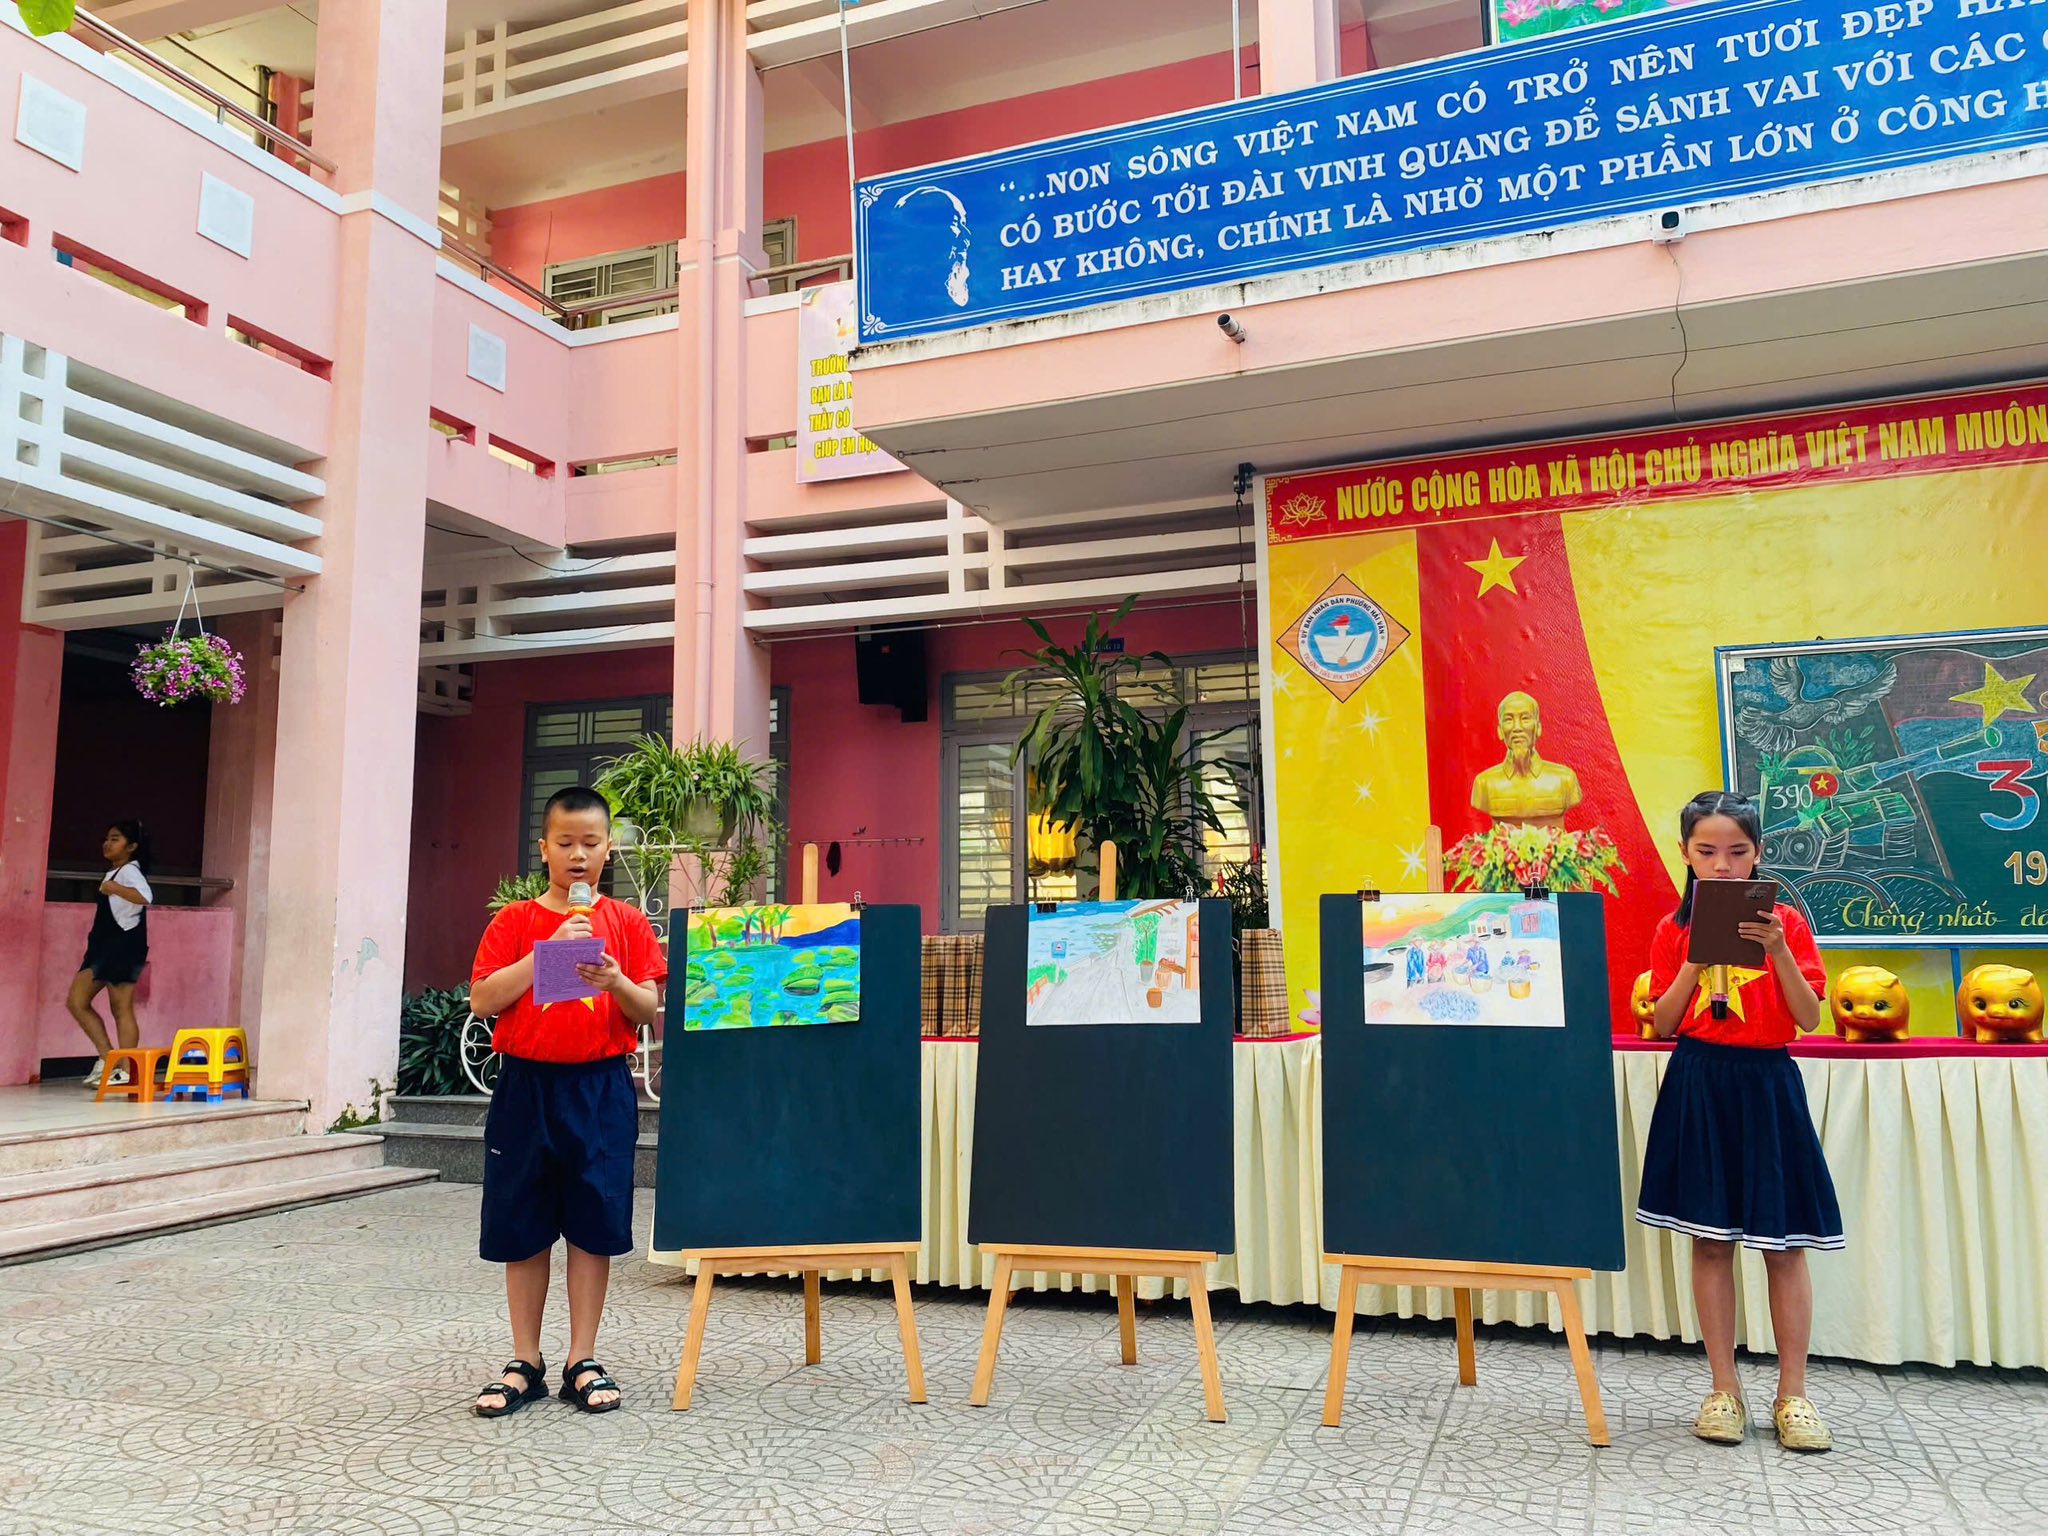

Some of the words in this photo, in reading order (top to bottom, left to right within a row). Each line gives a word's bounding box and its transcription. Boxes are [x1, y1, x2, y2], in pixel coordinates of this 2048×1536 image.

[1127, 140, 1219, 180] SÔNG
[1233, 119, 1319, 157] VIỆT
[1335, 100, 1418, 139] NAM
[1436, 80, 1487, 119] CÓ
[1506, 60, 1589, 107] TRỞ
[1609, 43, 1695, 85] NÊN
[1716, 18, 1820, 63] TƯƠI
[1840, 0, 1934, 40] ĐẸP
[1000, 212, 1041, 248] CÓ
[1053, 198, 1141, 240] BƯỚC
[1151, 182, 1211, 218] TỚI
[1221, 169, 1285, 206] ĐÀI
[1294, 152, 1386, 190] VINH
[1398, 126, 1532, 179] QUANG
[1544, 97, 1601, 147] ĐỂ
[1616, 87, 1731, 135] SÁNH
[1743, 70, 1820, 108] VAI
[1832, 49, 1914, 91] VỚI
[1929, 31, 2026, 74] CÁC
[1000, 257, 1066, 291] HAY
[1075, 233, 1204, 277] KHÔNG,
[1217, 208, 1332, 251] CHÍNH
[1343, 192, 1393, 229] LÀ
[1403, 176, 1484, 219] NHỜ
[1497, 163, 1586, 203] MỘT
[1599, 133, 1713, 187] PHẦN
[1727, 121, 1814, 163] LỚN
[1831, 105, 1860, 144] Ở
[1878, 89, 2008, 136] CÔNG
[810, 384, 831, 406] BẠN
[833, 380, 844, 401] LÀ
[815, 436, 839, 459] GIÚP
[840, 436, 855, 455] EM
[1337, 476, 1404, 520] NƯỚC
[1411, 469, 1480, 517] CỘNG
[1488, 460, 1542, 503] HÒA
[1548, 454, 1583, 497] XÃ
[1589, 448, 1638, 498] HỘI
[1640, 437, 1702, 487] CHỦ
[1710, 430, 1801, 482] NGHĨA
[1805, 421, 1869, 472] VIỆT
[1878, 416, 1947, 462] NAM
[1955, 400, 2048, 452] MUÔN
[1769, 784, 1813, 810] 390
[2003, 850, 2048, 885] 19
